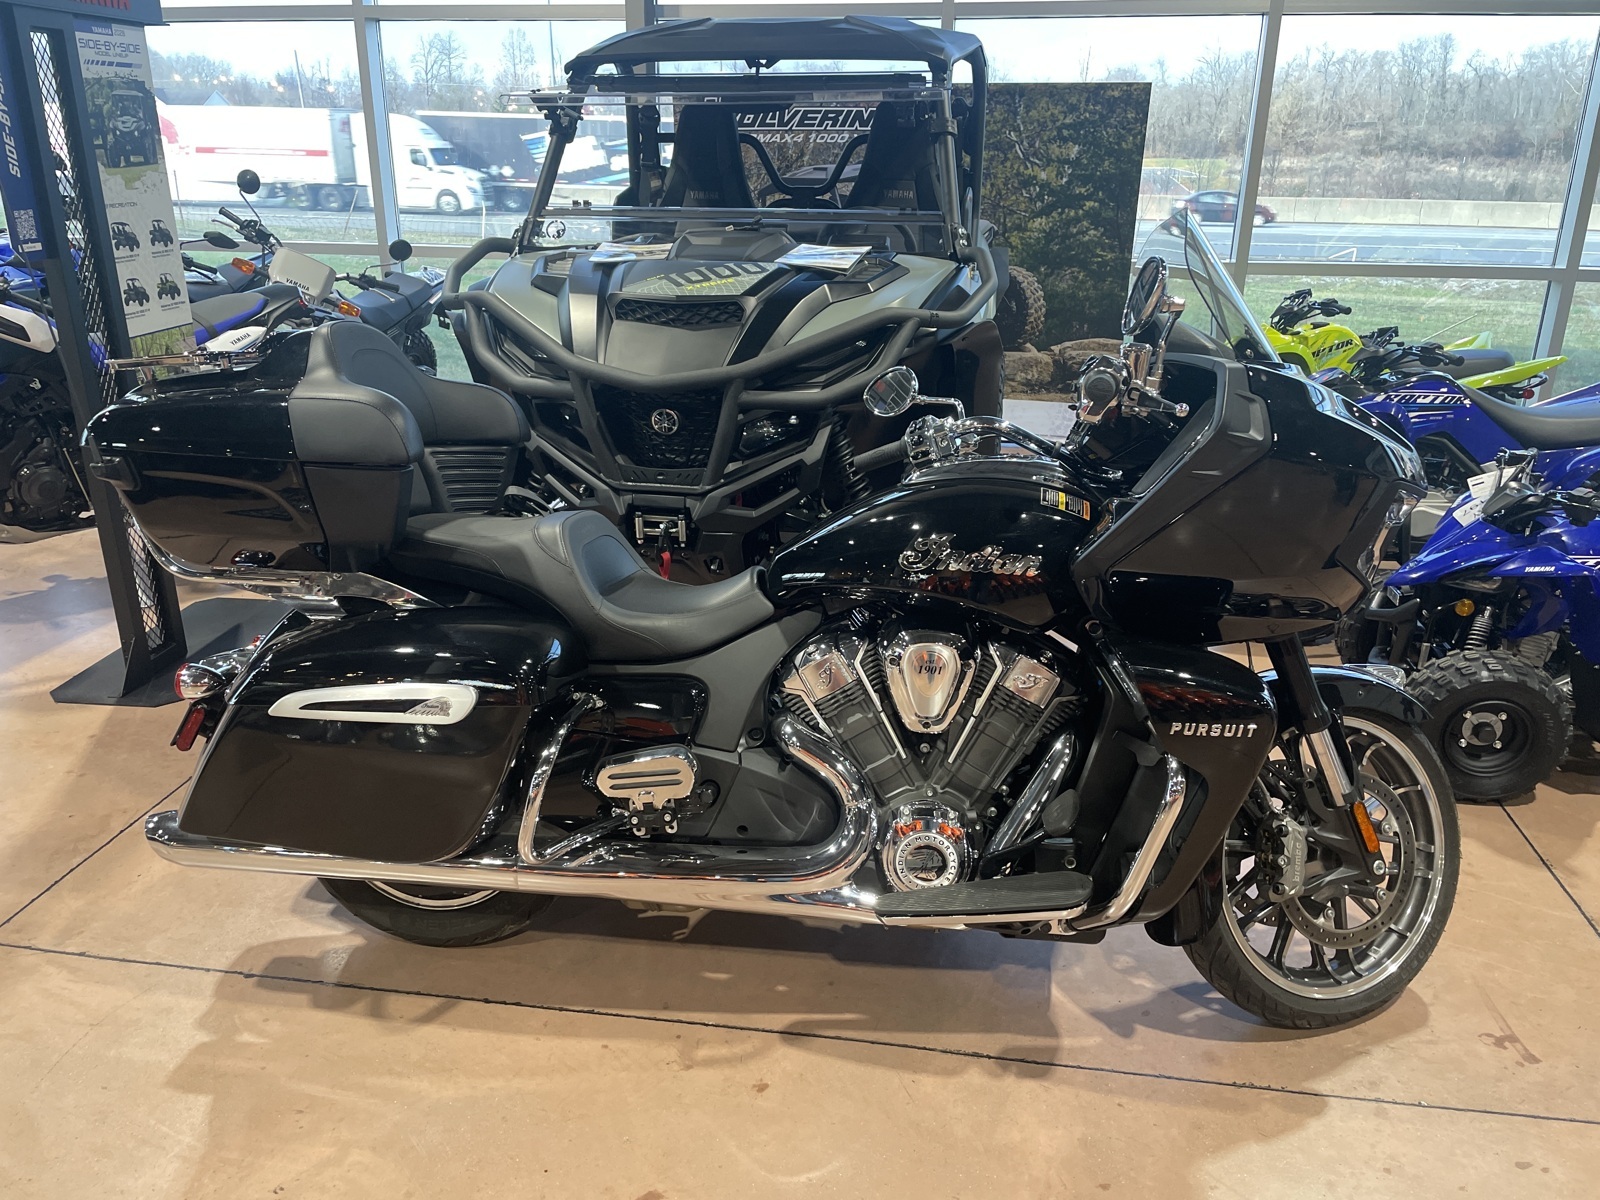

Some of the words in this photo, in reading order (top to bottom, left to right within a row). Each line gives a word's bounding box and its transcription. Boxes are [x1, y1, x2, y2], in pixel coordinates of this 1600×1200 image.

[91, 26, 113, 35] YAMAHA
[78, 38, 142, 54] SIDE-BY-SIDE
[808, 133, 849, 143] 1000
[690, 190, 720, 200] YAMAHA
[883, 189, 914, 199] YAMAHA
[661, 262, 770, 288] 1000
[285, 277, 310, 292] YAMAHA
[229, 332, 252, 346] YAMAHA
[898, 533, 1043, 577] Indian
[918, 665, 943, 675] 1901
[1169, 722, 1258, 738] PURSUIT
[898, 842, 912, 879] INDIAN
[915, 836, 957, 883] MOTORCYCLE
